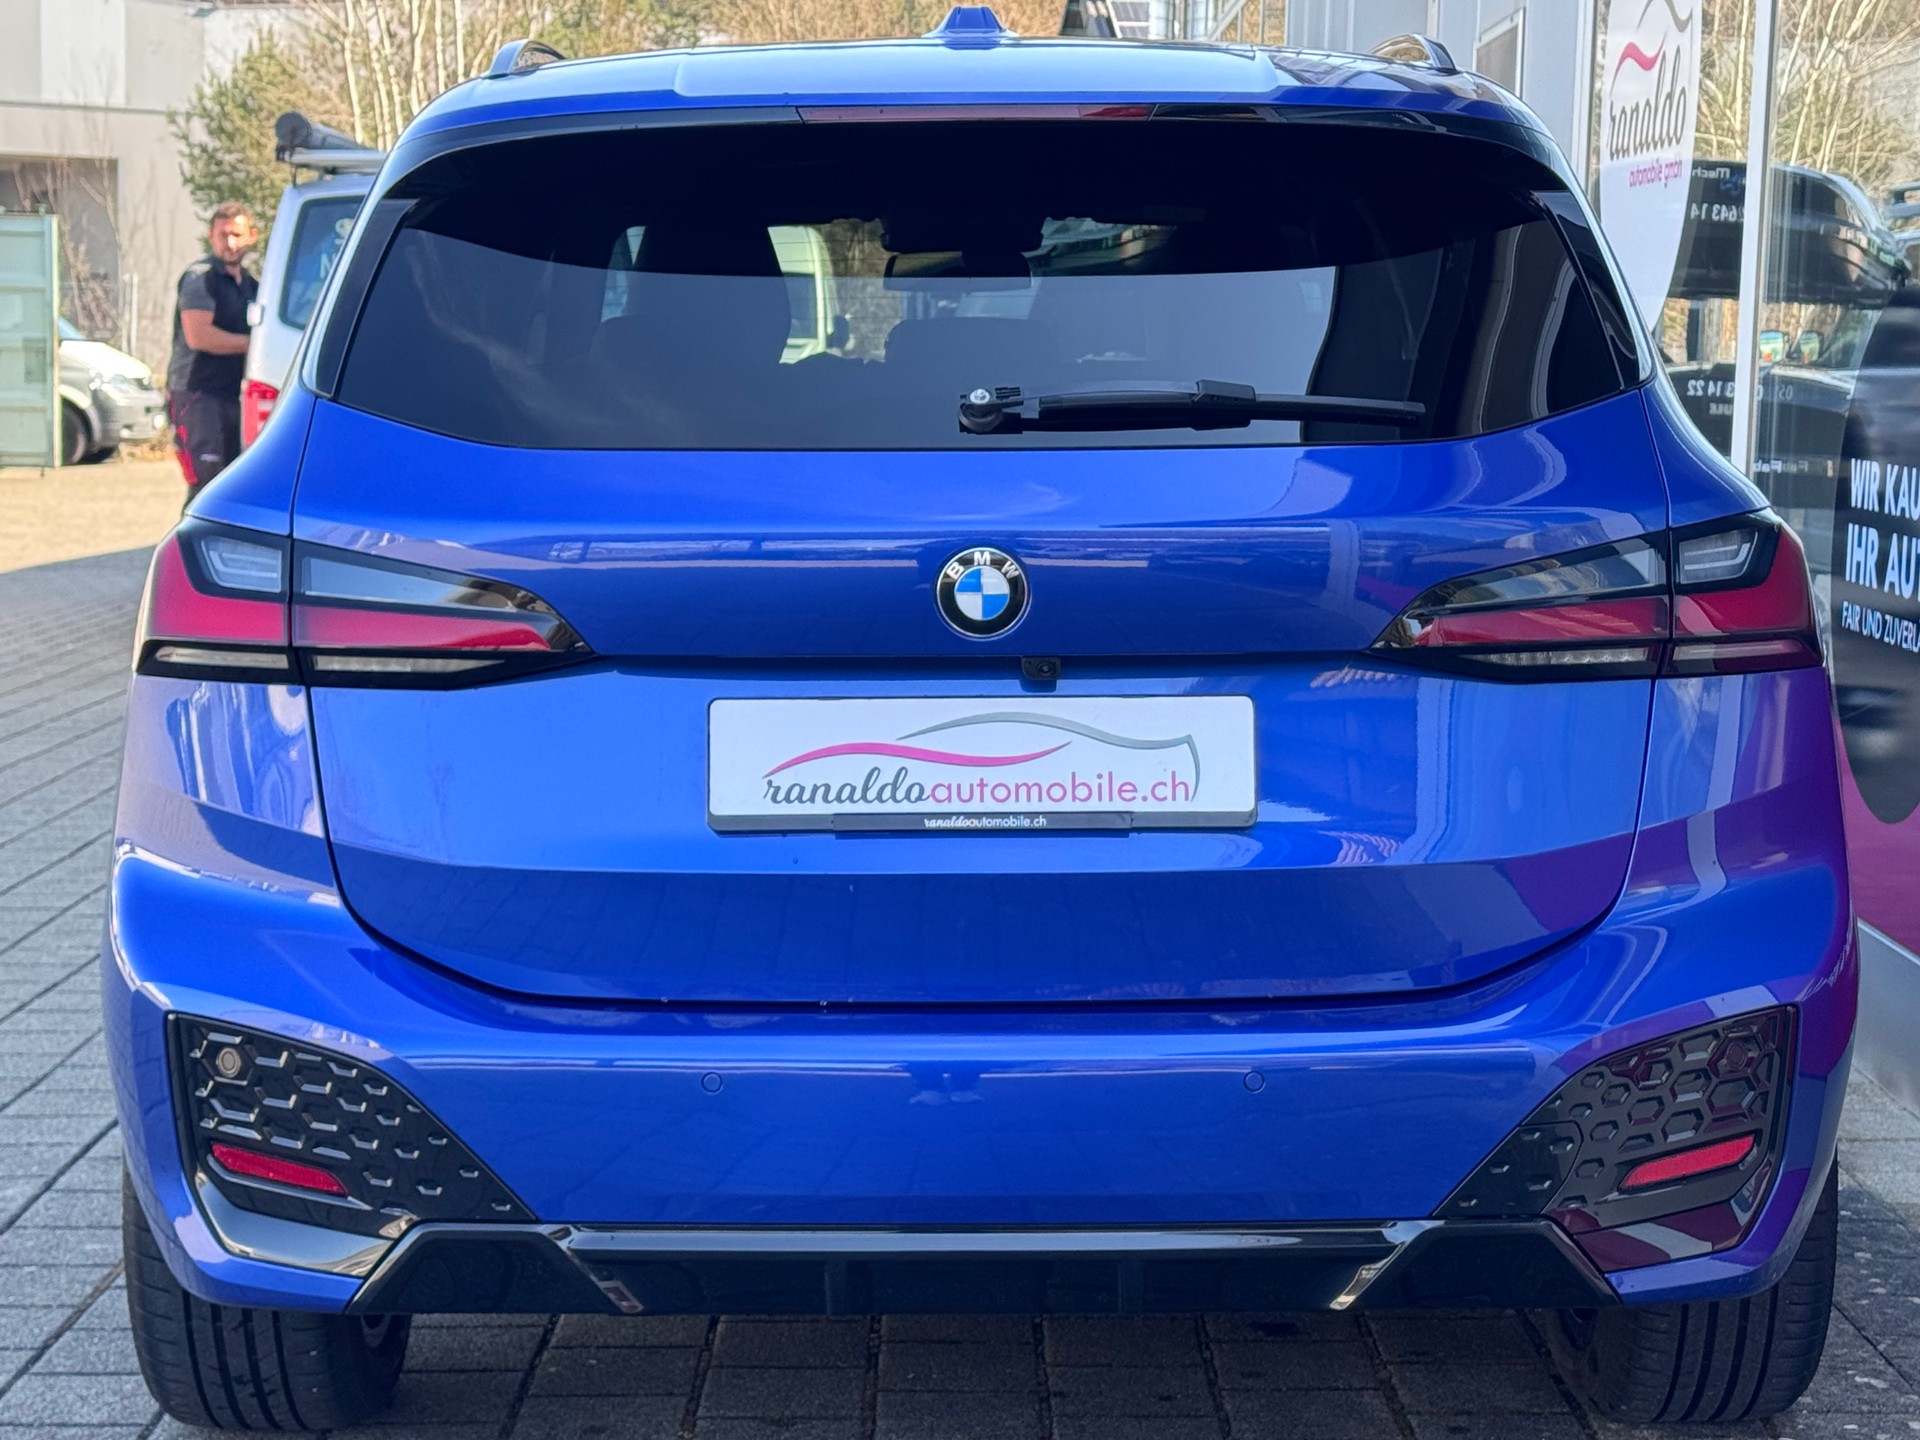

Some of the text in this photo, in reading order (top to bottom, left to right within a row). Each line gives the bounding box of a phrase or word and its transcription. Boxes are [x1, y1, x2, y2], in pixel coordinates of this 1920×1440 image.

[1606, 45, 1687, 161] ranaldo
[1851, 457, 1880, 513] WIR
[946, 551, 1020, 580] BMW
[1845, 522, 1879, 590] IHR
[1841, 600, 1861, 633] FAIR
[1862, 606, 1882, 640] UND
[763, 766, 1191, 805] ranaldoautomobile.ch
[924, 815, 1047, 828] ranaldoautomobile.ch
